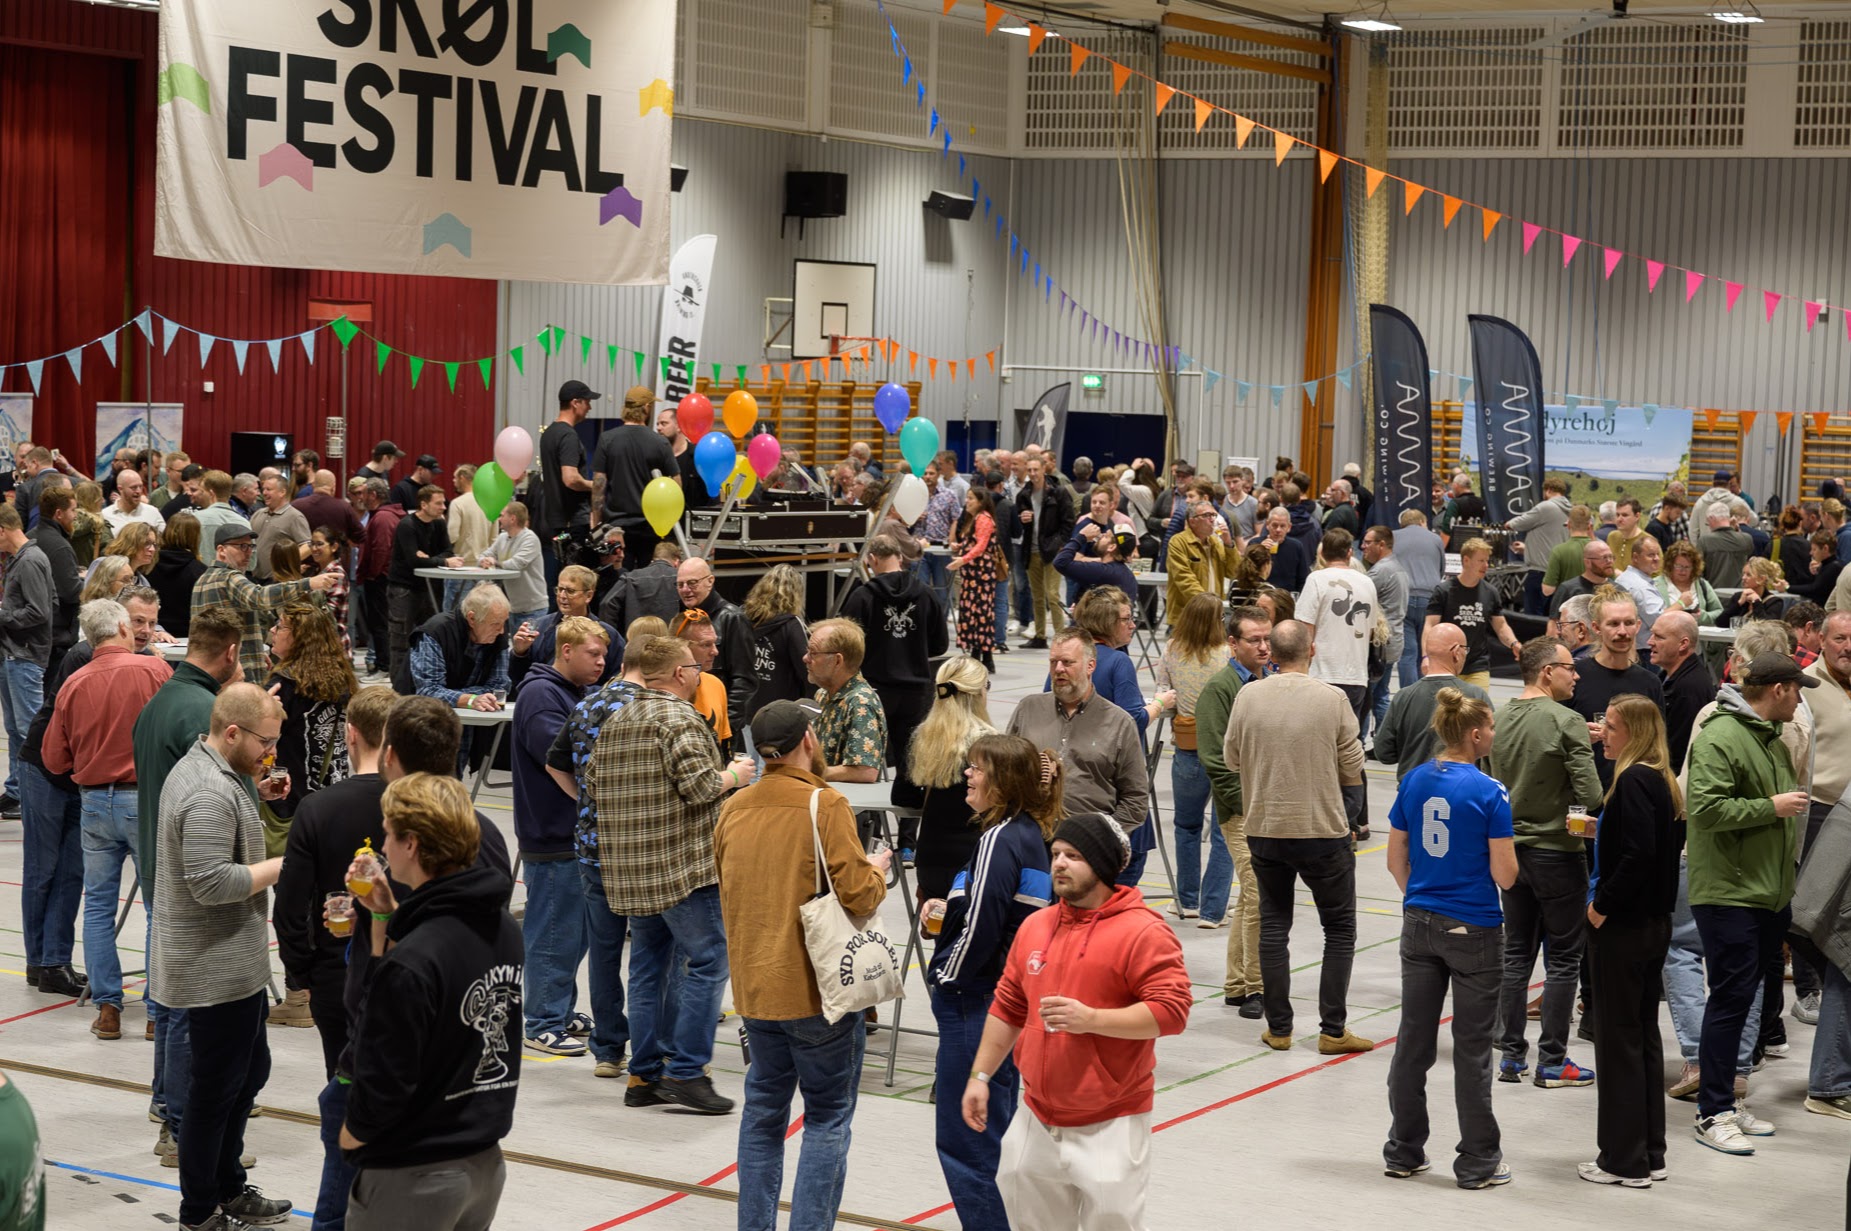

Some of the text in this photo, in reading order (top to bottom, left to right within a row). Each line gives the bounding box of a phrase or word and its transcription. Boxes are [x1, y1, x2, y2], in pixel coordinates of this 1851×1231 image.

[227, 46, 624, 194] FESTIVAL
[665, 336, 696, 403] BEER
[1422, 796, 1451, 858] 6
[841, 929, 899, 987] SYD FOR SOLEN
